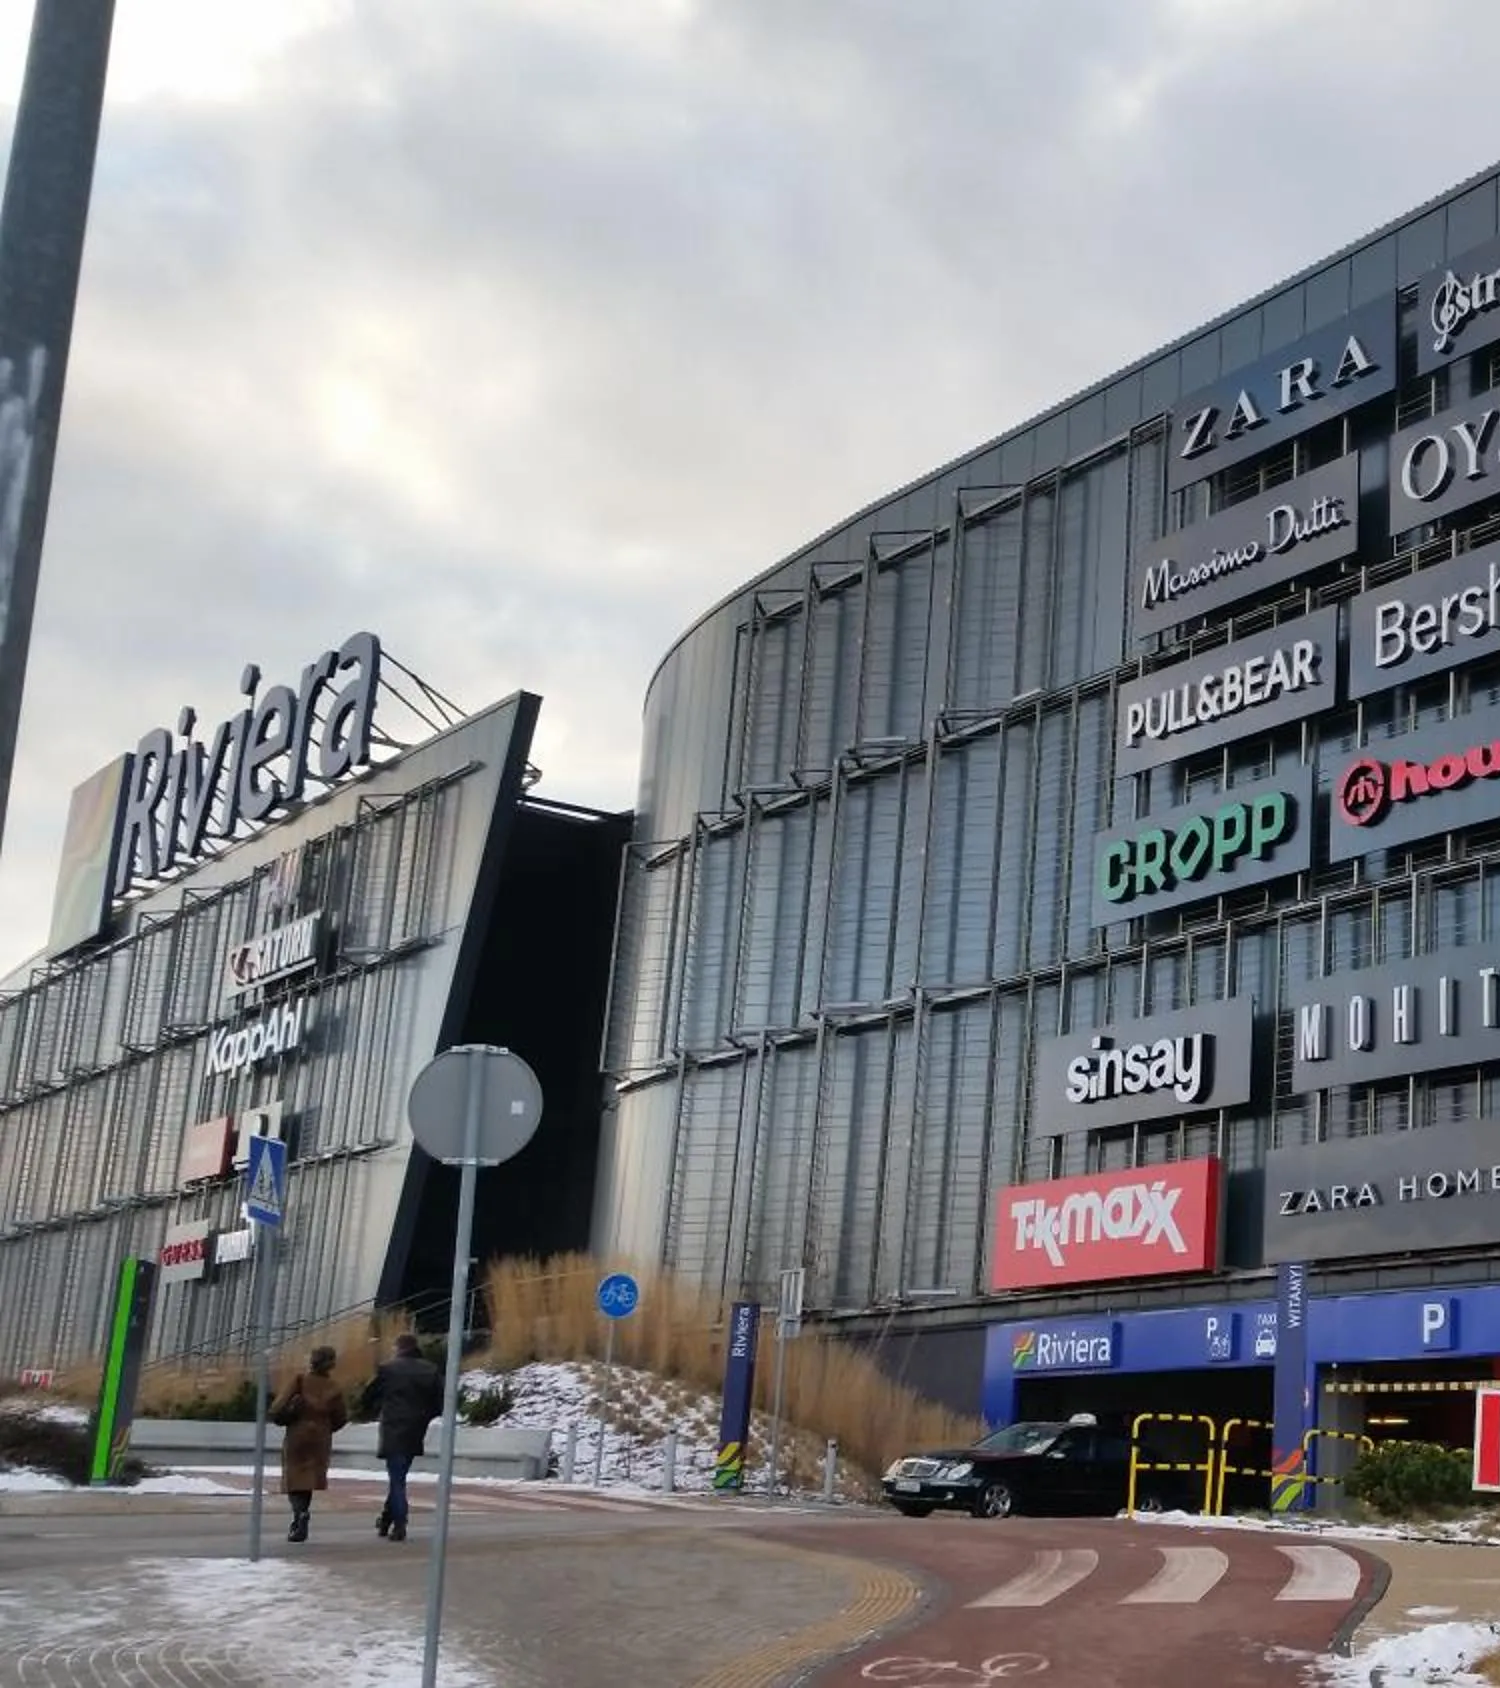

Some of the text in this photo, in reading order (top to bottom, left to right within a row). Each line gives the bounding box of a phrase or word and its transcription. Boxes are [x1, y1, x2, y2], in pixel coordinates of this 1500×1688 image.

[1179, 335, 1375, 459] ZARA
[1141, 496, 1345, 609] Massimo Dutti
[1125, 639, 1317, 748] PULL&BEAR
[116, 631, 381, 897] Riviera
[1102, 791, 1287, 902] CROPP
[206, 998, 304, 1078] KappAhl
[1066, 1033, 1203, 1103] sinsay
[1279, 1182, 1376, 1215] ZARA
[731, 1307, 750, 1355] Riviera
[1037, 1332, 1111, 1366] Riviera
[1207, 1317, 1218, 1339] P
[1422, 1303, 1446, 1343] P
